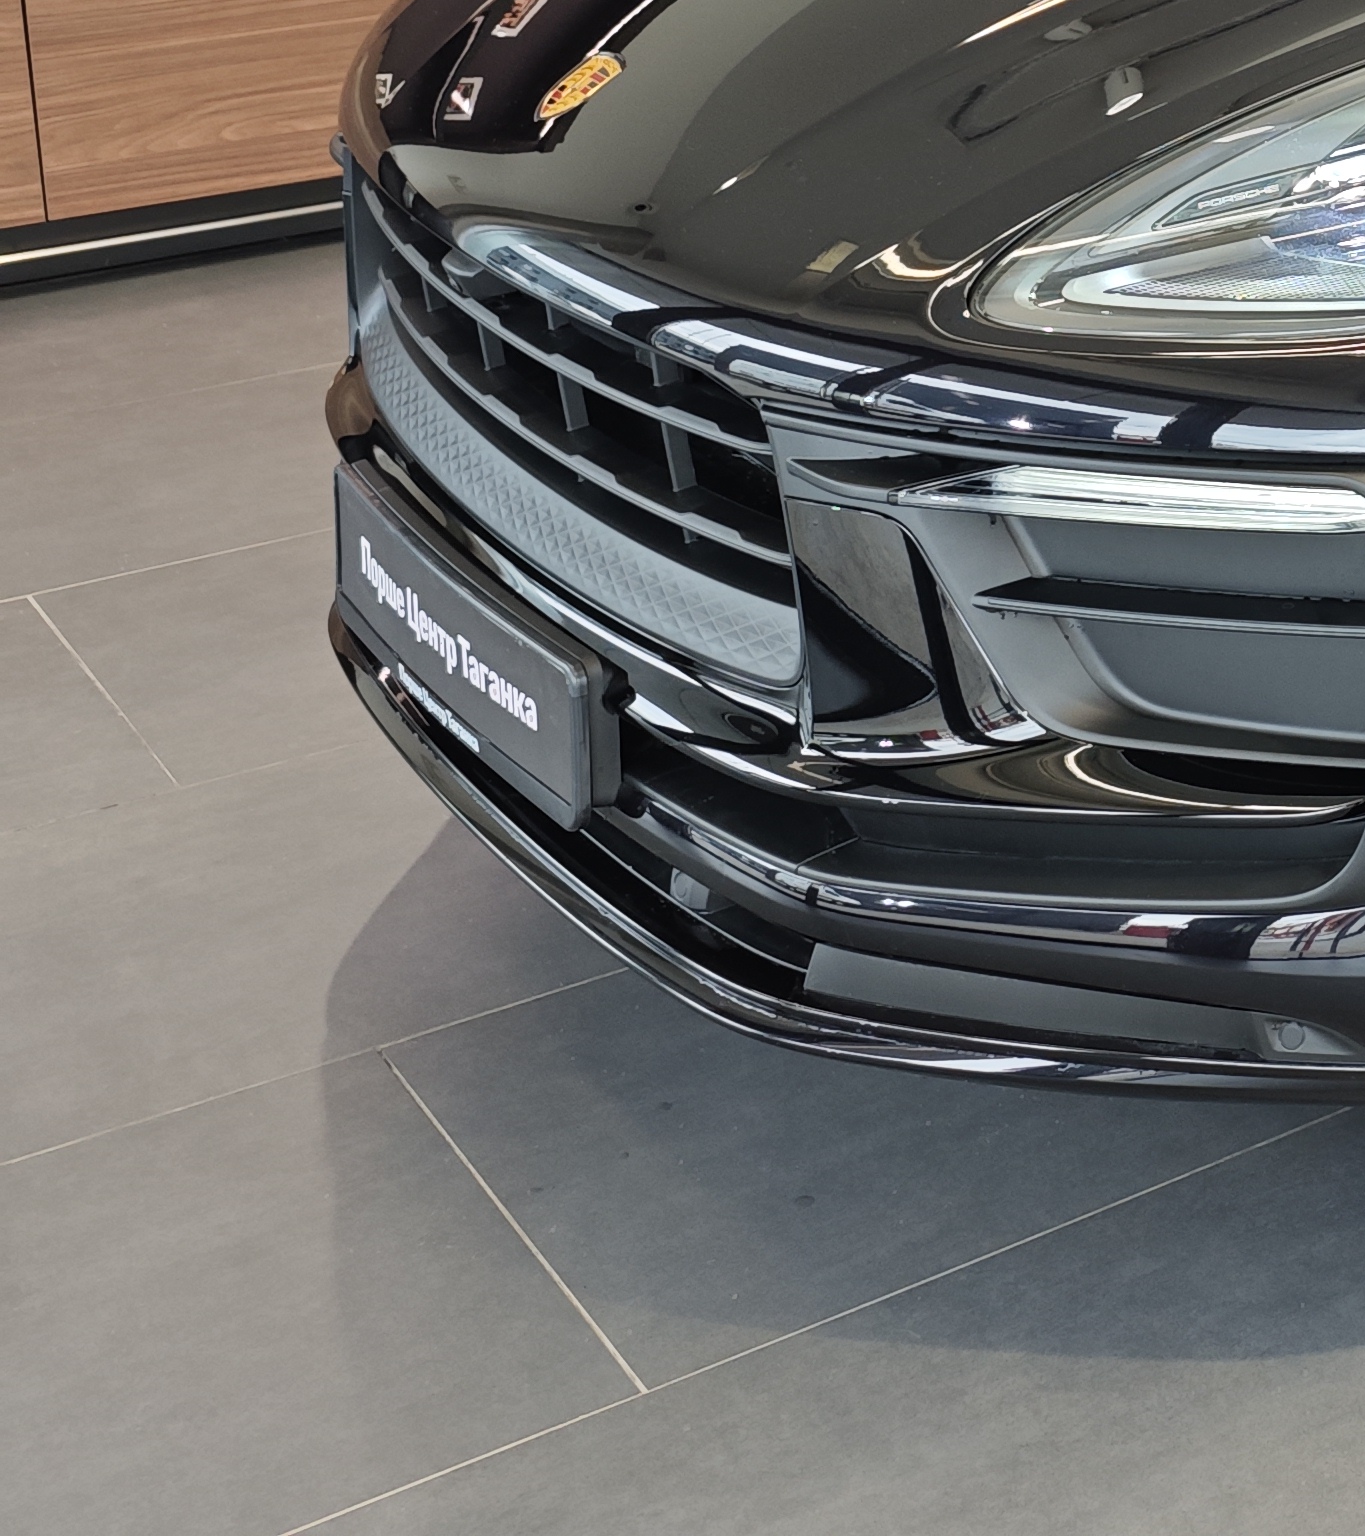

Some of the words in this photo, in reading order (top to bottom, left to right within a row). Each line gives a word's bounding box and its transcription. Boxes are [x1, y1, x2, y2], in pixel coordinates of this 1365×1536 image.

[1198, 184, 1279, 209] PORSCHE
[360, 535, 405, 618] Порше
[406, 587, 457, 674] Центр
[457, 634, 538, 731] Таганка
